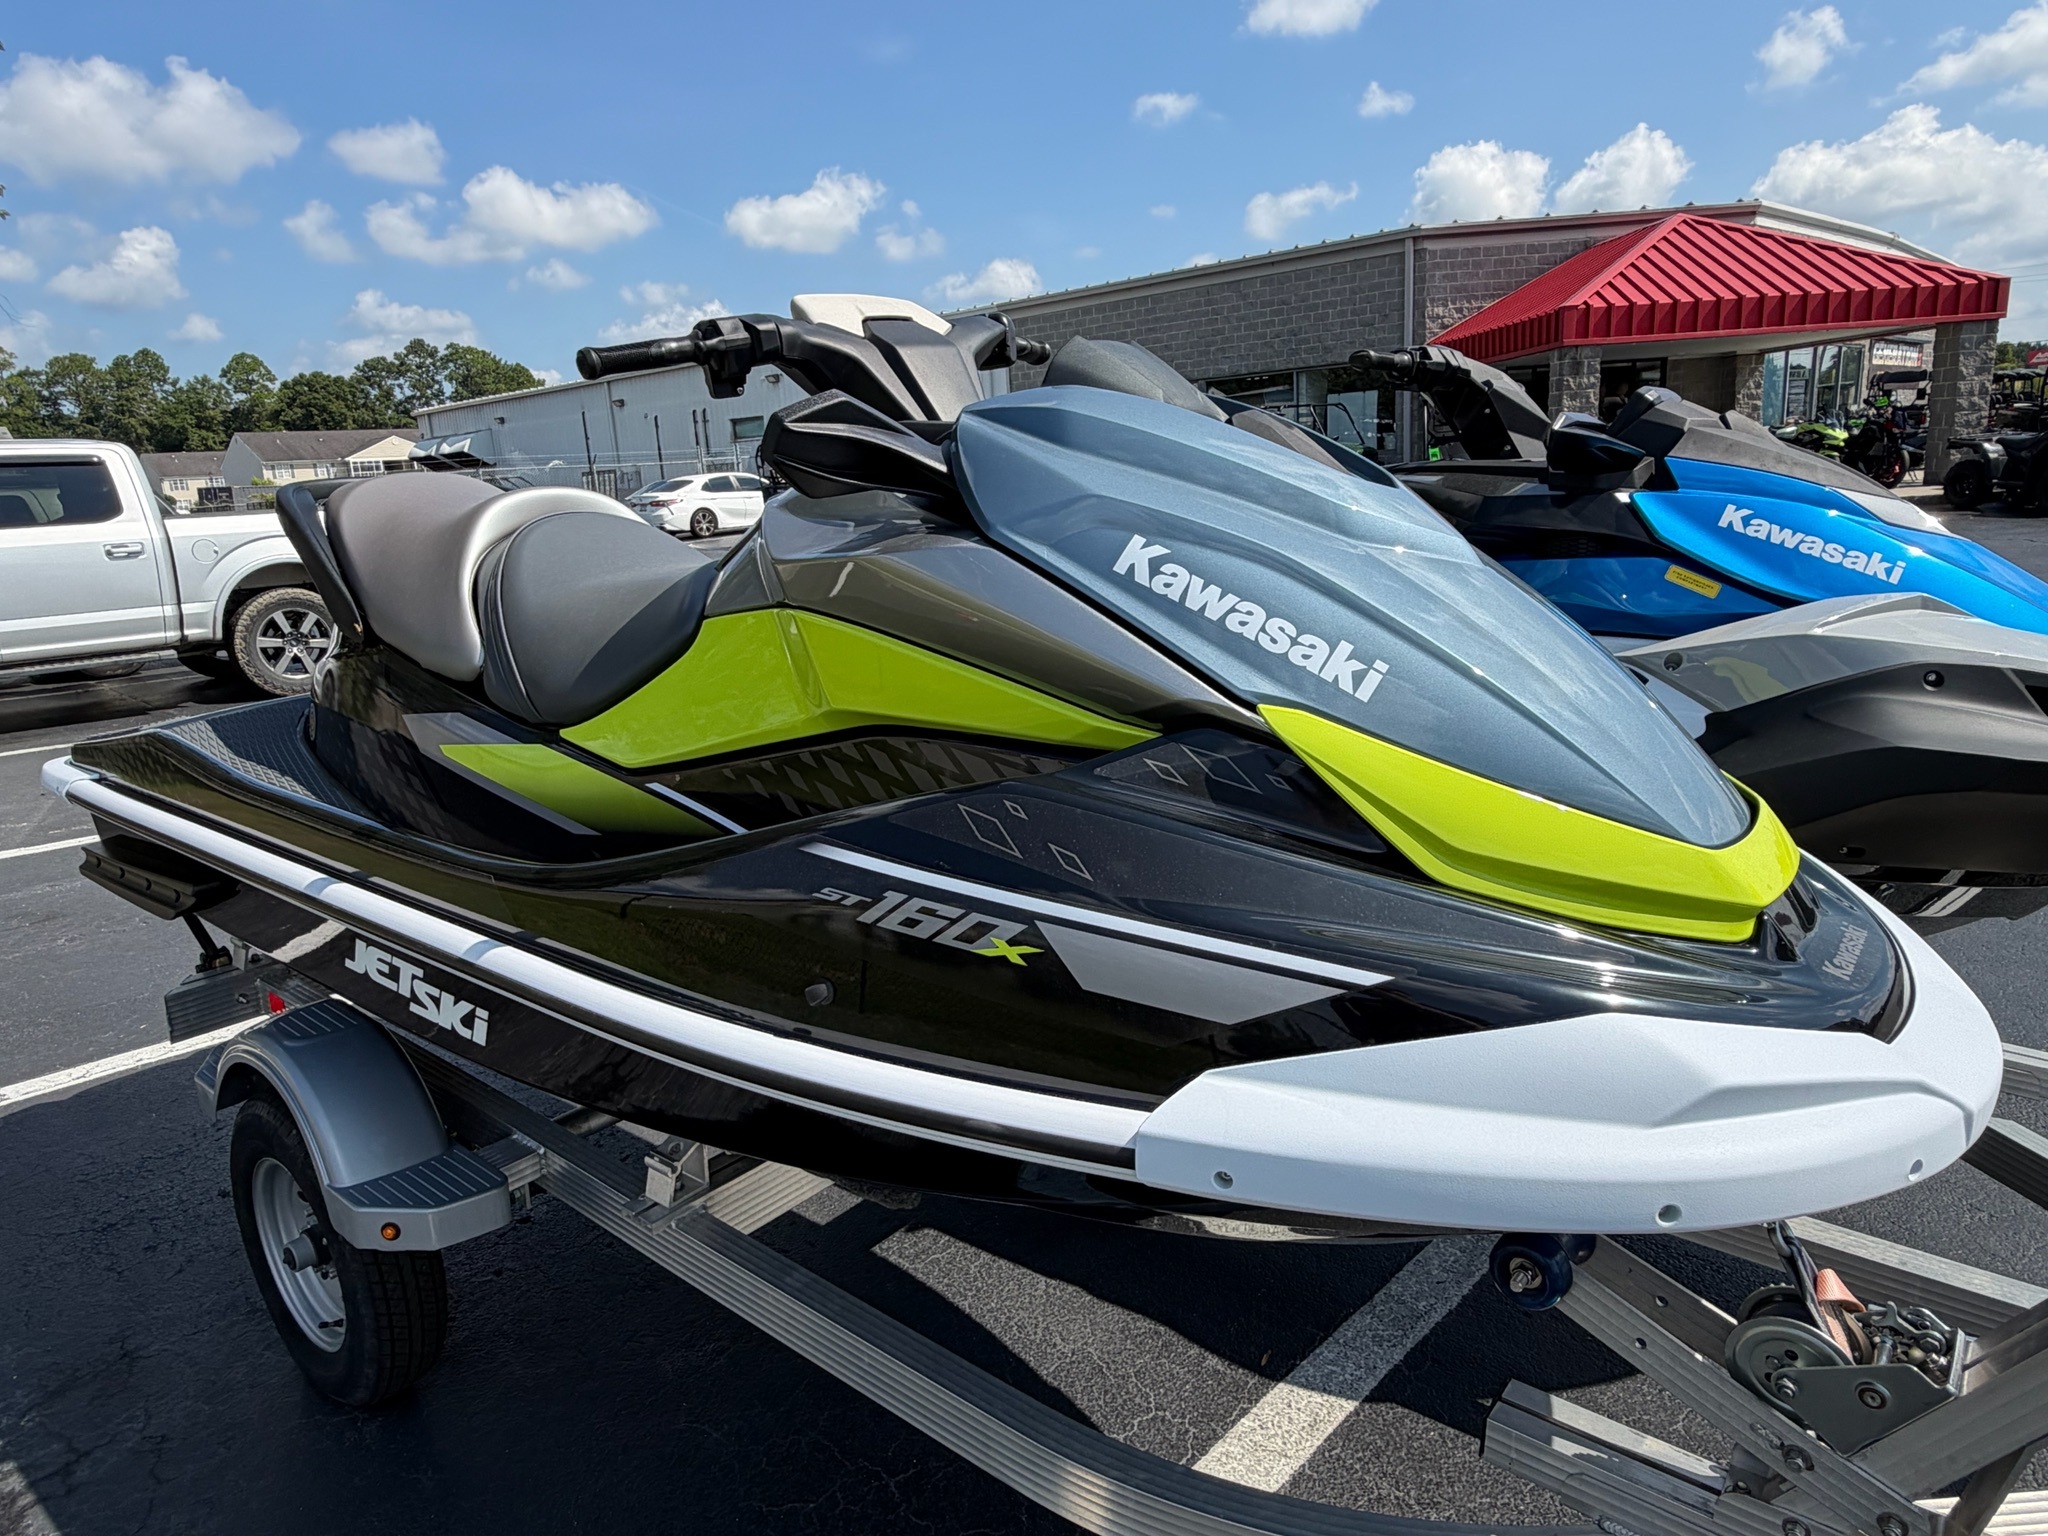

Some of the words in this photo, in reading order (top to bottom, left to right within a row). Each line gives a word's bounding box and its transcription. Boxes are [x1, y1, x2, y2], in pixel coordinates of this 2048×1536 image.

[1717, 503, 1907, 585] Kawasaki
[1112, 533, 1390, 703] Kawasaki
[812, 887, 873, 906] ST
[1821, 921, 1869, 981] Kawasaki
